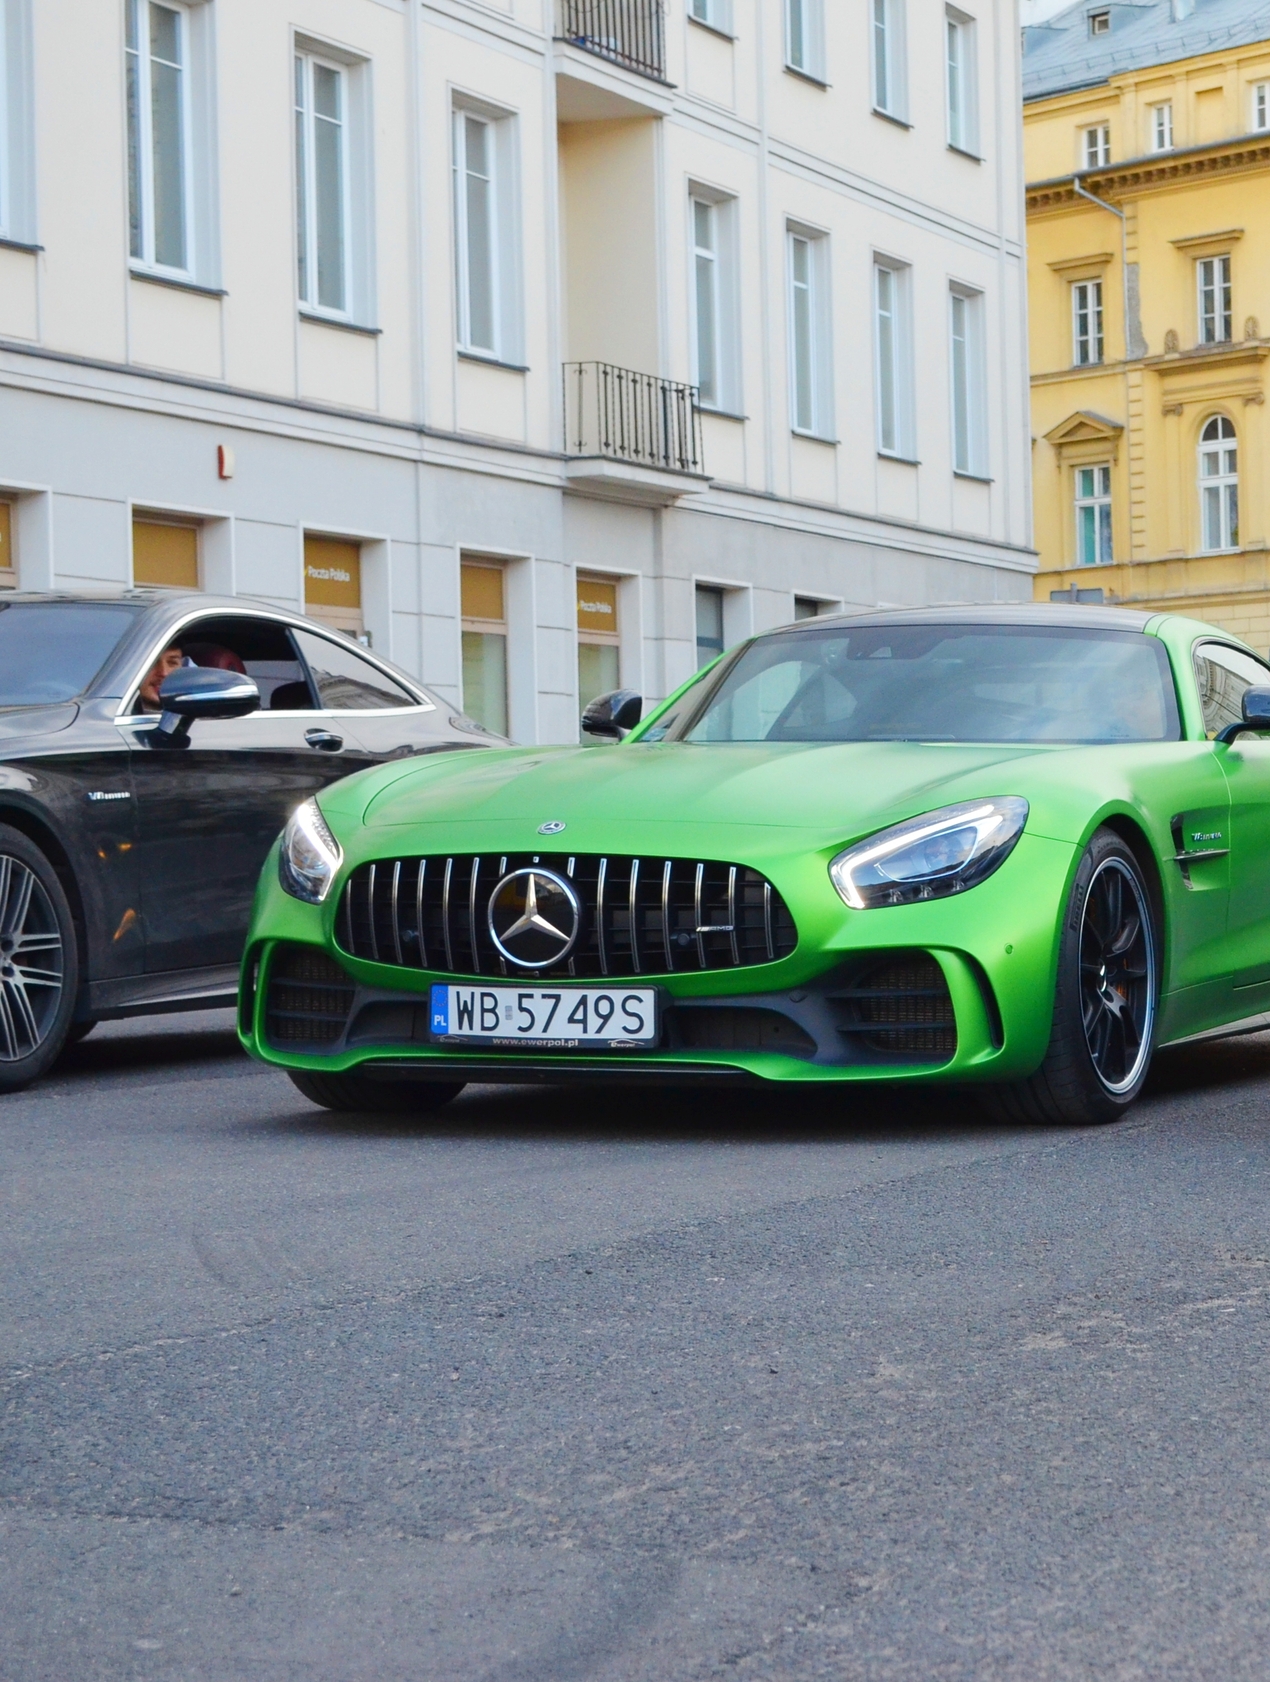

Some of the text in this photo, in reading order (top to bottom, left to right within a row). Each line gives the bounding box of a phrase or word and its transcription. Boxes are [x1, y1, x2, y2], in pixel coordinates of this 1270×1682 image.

[308, 565, 350, 581] Poczta Polska
[456, 990, 644, 1034] WB 5749S
[434, 1015, 446, 1026] PL
[492, 1037, 578, 1047] www.ewerpol.pl
